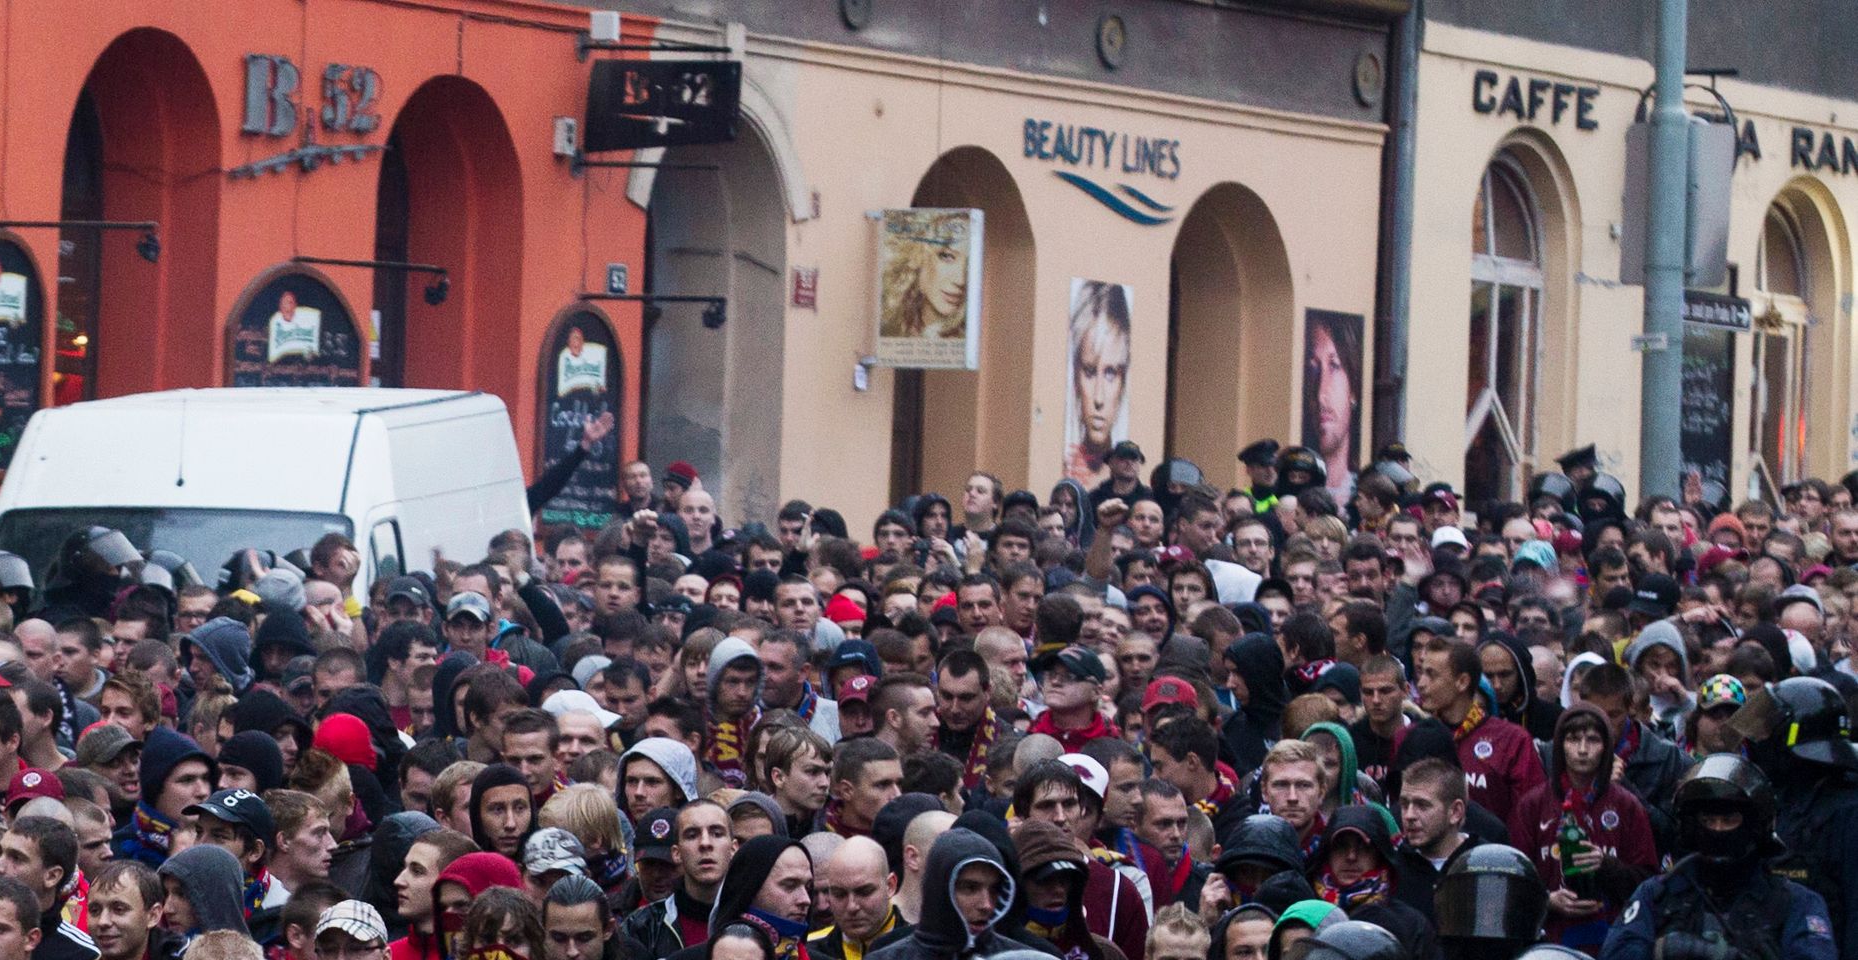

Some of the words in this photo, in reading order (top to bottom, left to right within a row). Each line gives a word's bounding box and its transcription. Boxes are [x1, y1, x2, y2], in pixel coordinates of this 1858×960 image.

[321, 63, 385, 134] 52
[1473, 69, 1600, 131] CAFFE
[1023, 118, 1116, 168] BEAUTY
[1121, 133, 1181, 181] LINES
